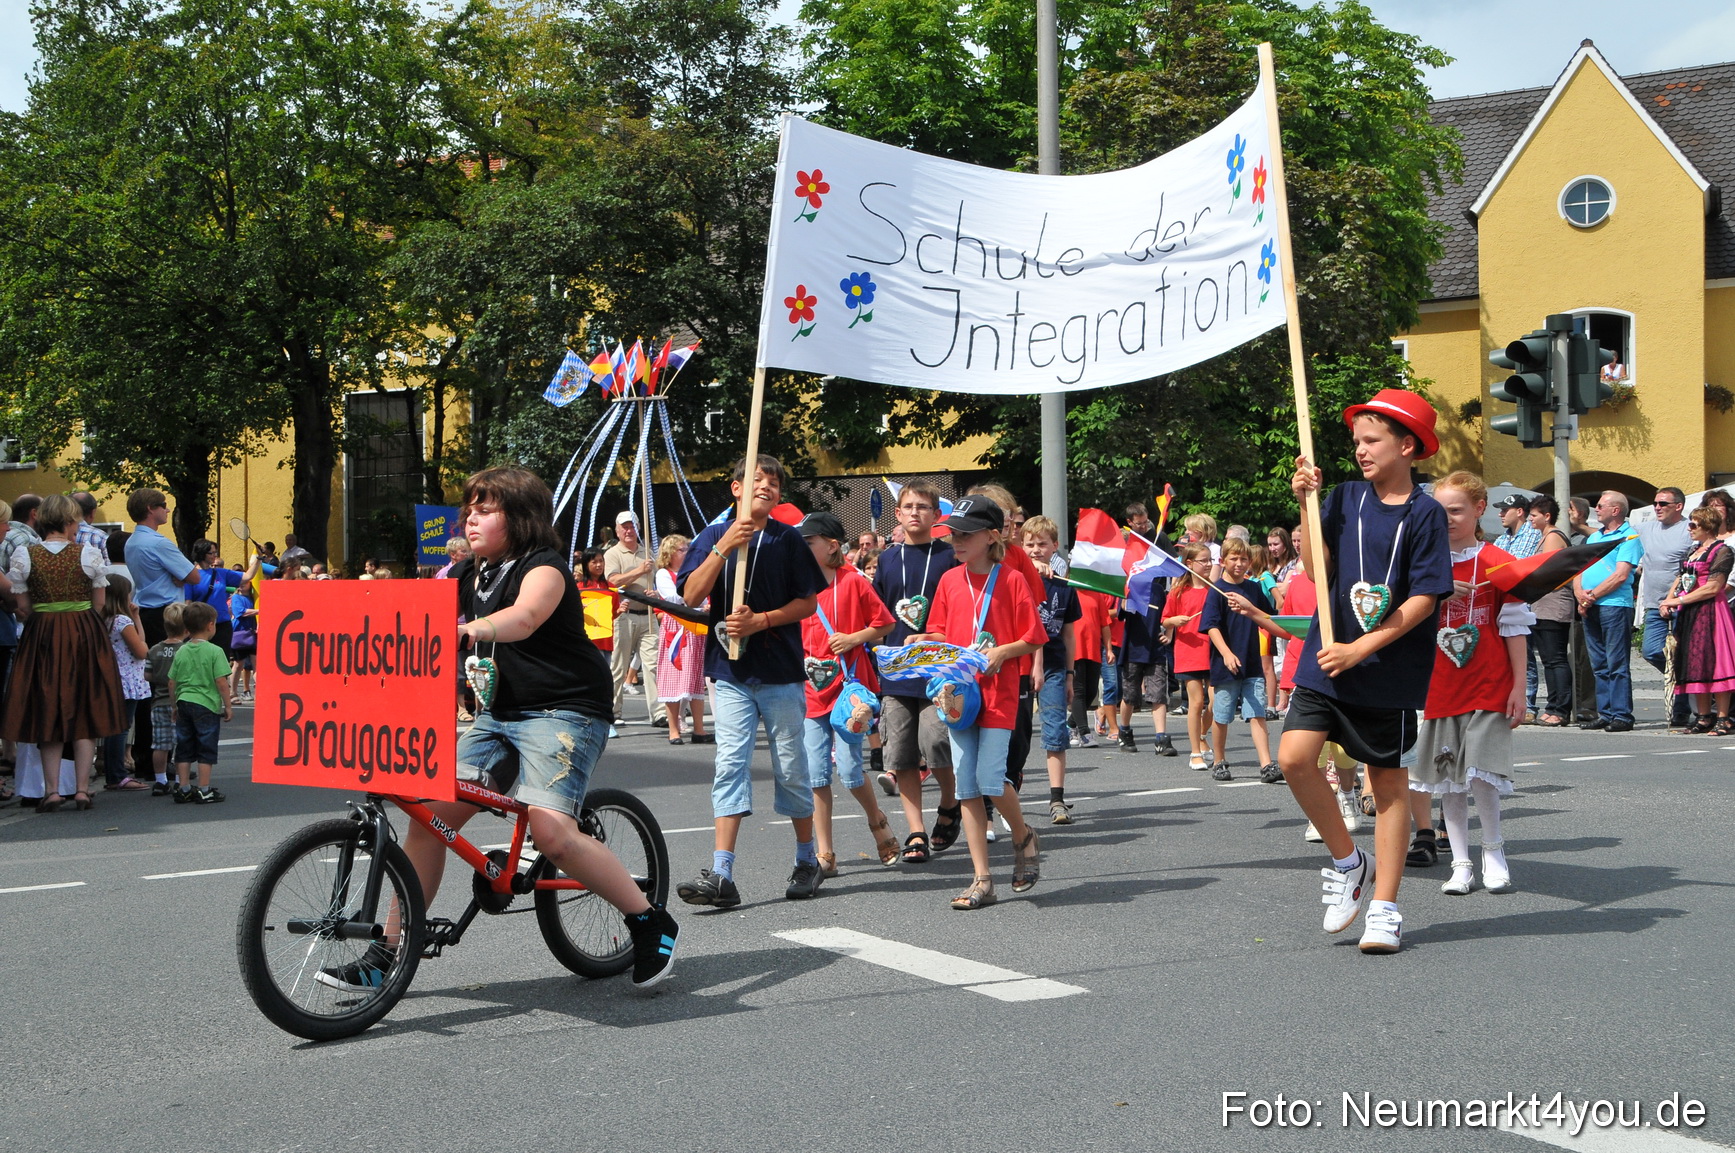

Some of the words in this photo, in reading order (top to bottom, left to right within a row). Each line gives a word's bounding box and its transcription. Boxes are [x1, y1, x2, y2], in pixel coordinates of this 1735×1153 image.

[847, 182, 1085, 280] Schule
[1124, 192, 1211, 262] der
[421, 526, 444, 541] SCHULE
[424, 516, 446, 530] GRUND
[162, 646, 174, 658] 36
[275, 609, 442, 677] Grundschule
[273, 692, 438, 784] Bräugasse
